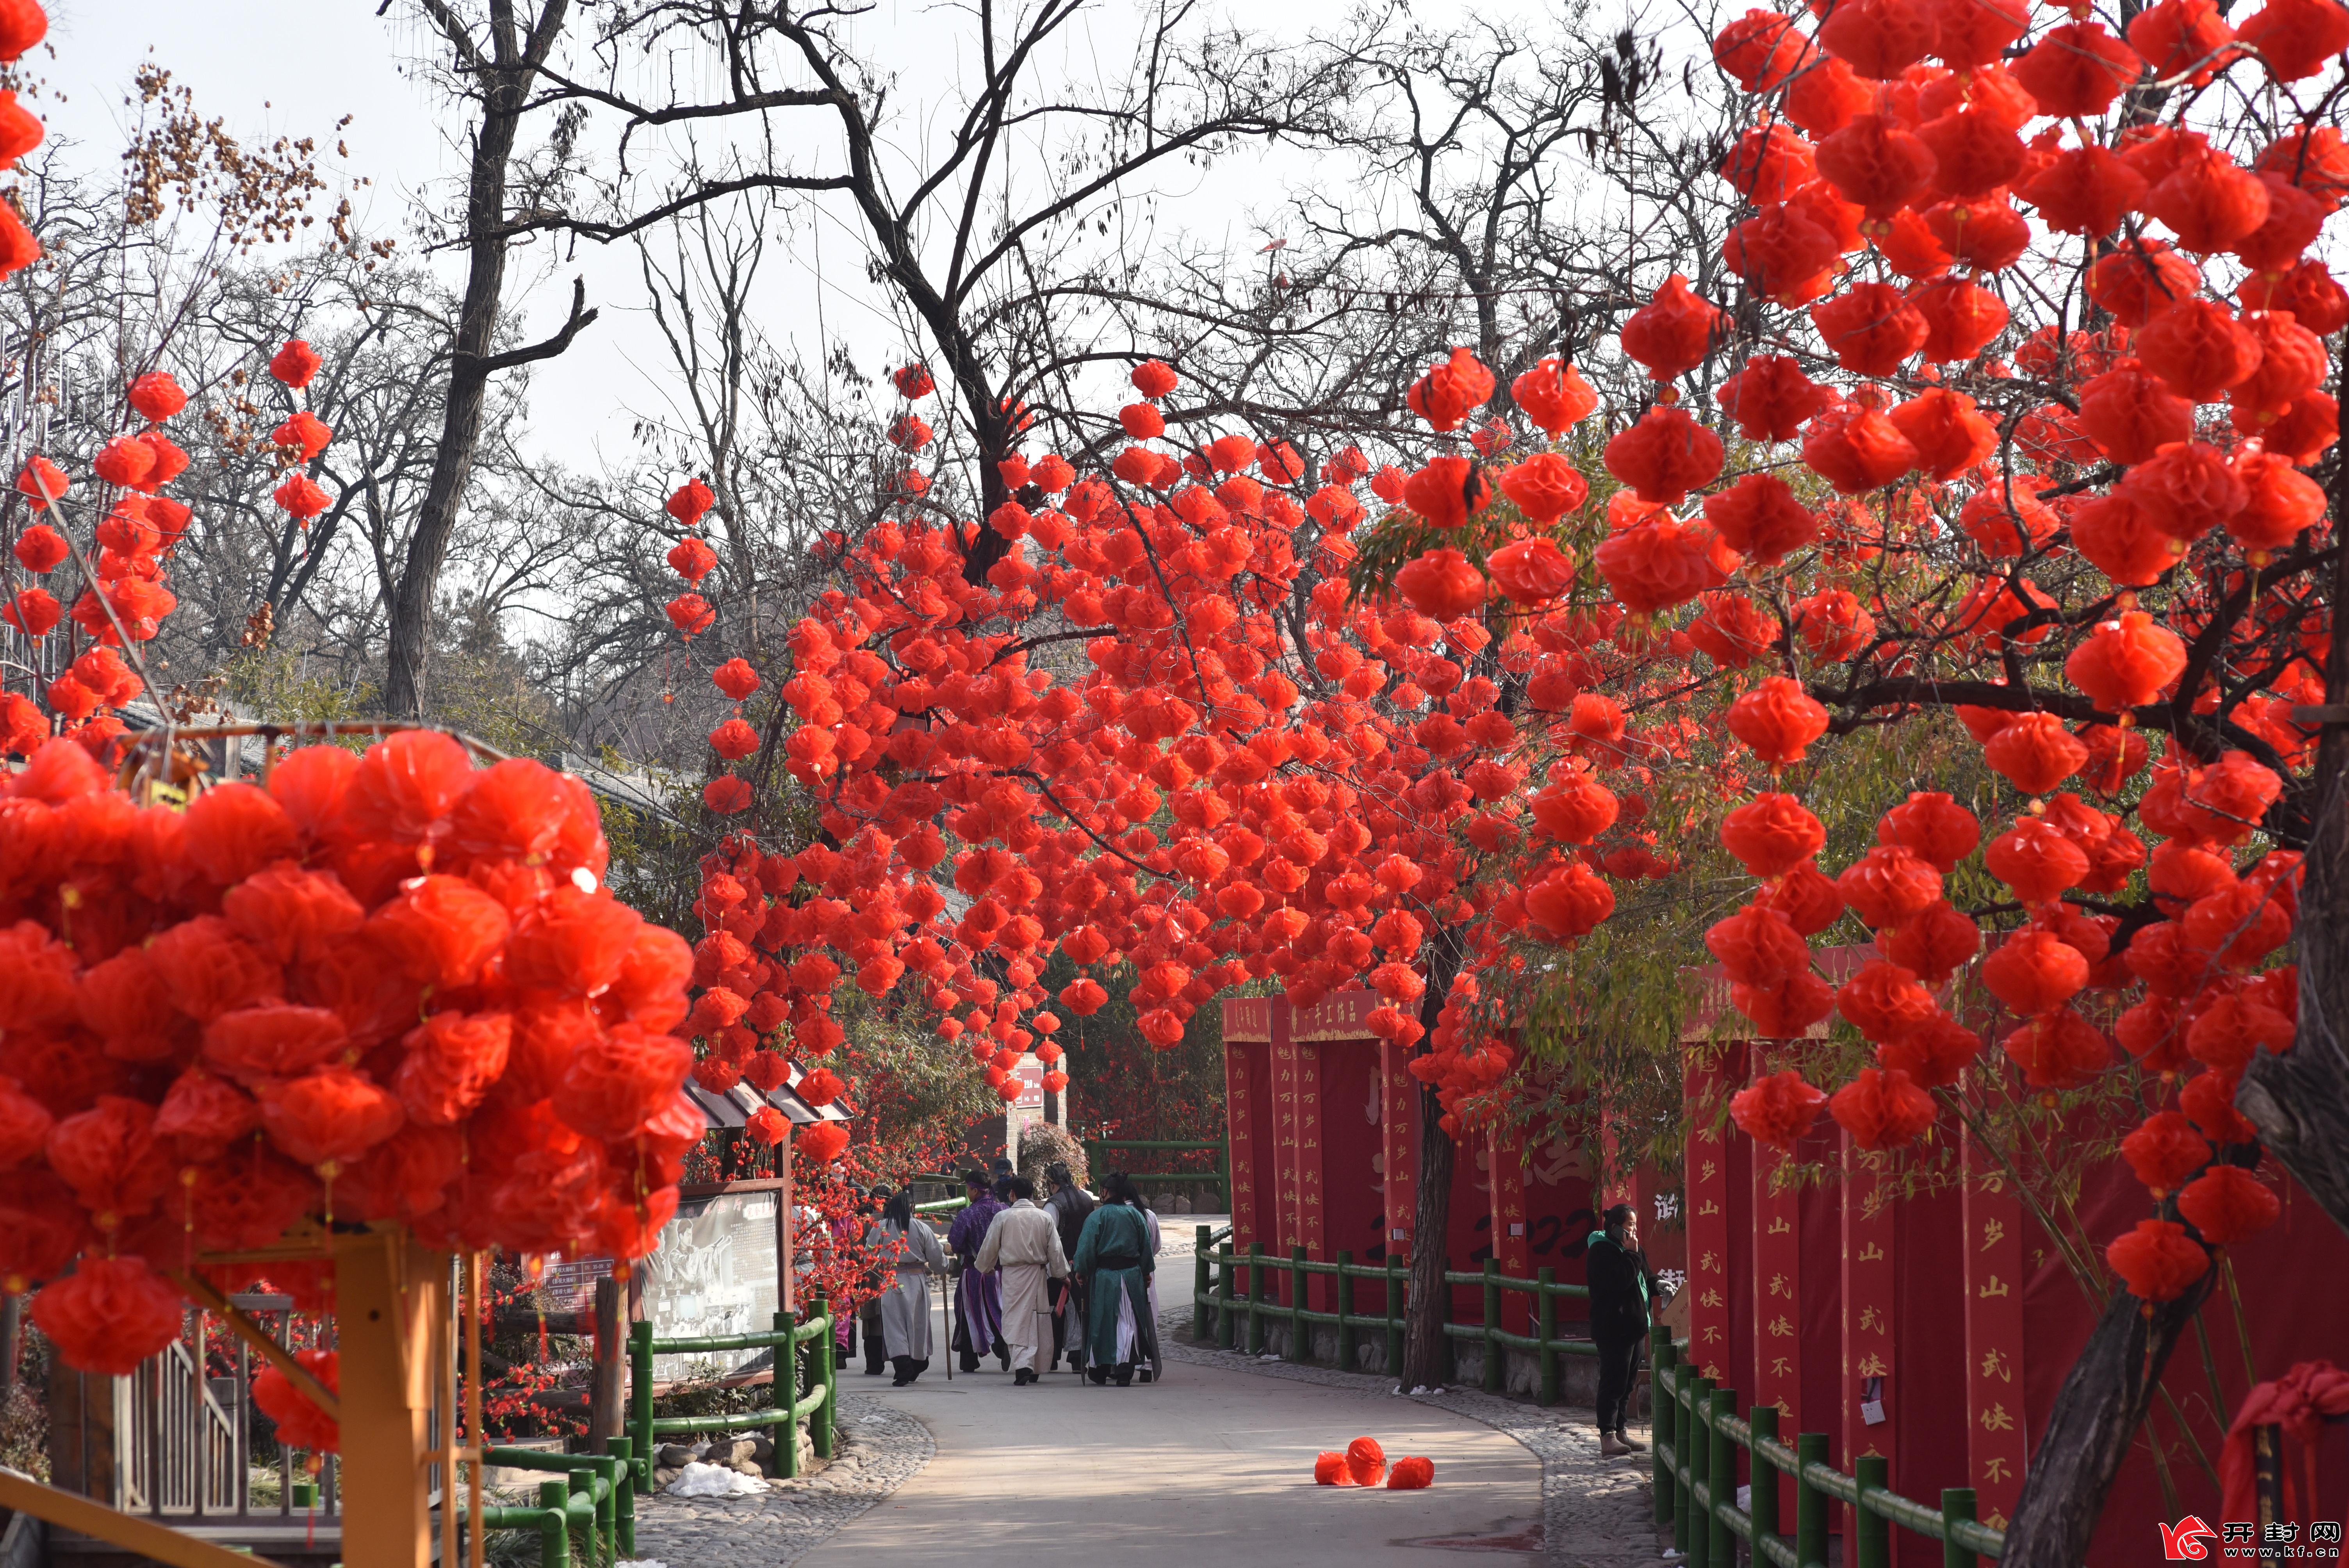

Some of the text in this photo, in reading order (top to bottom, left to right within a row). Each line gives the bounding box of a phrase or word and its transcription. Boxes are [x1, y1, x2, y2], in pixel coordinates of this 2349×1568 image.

[1314, 1000, 1356, 1026] 手工饰品
[1232, 1046, 1248, 1140] 魅力万岁山
[1277, 1046, 1294, 1146] 魅力万岁山
[1301, 1046, 1317, 1148] 魅力万岁山
[1393, 1073, 1409, 1181] 魅力万岁山
